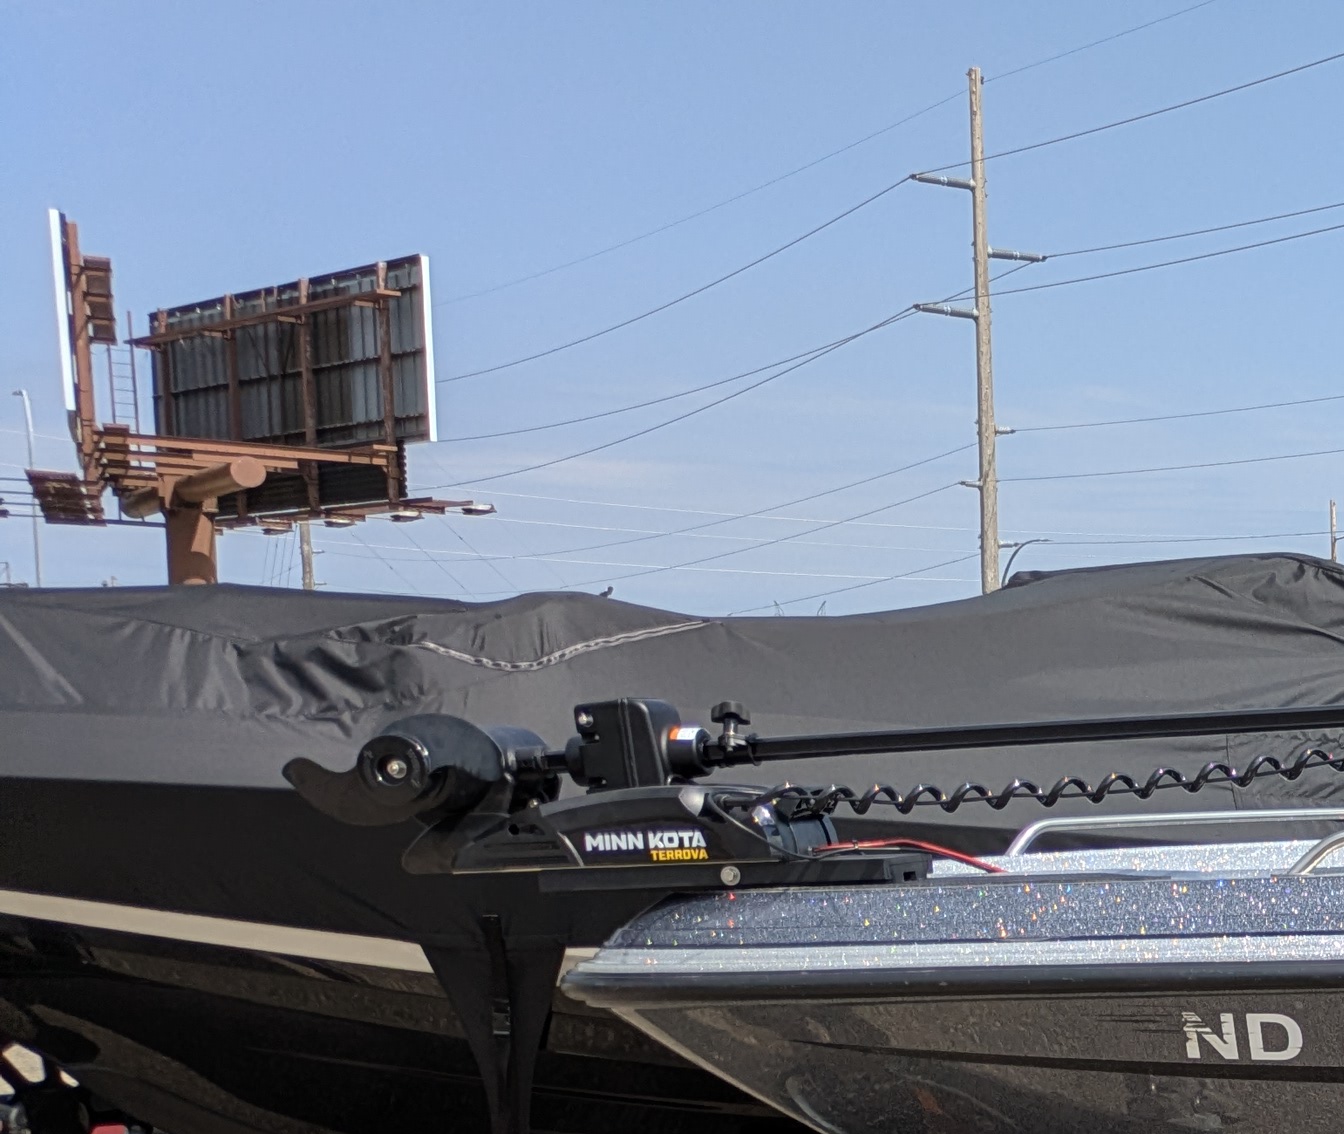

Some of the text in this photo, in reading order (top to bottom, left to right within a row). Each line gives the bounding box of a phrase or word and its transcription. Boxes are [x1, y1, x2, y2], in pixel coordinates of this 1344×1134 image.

[584, 828, 707, 852] MINN KOTA
[650, 848, 709, 861] TERROVA
[1182, 1013, 1303, 1061] ND
